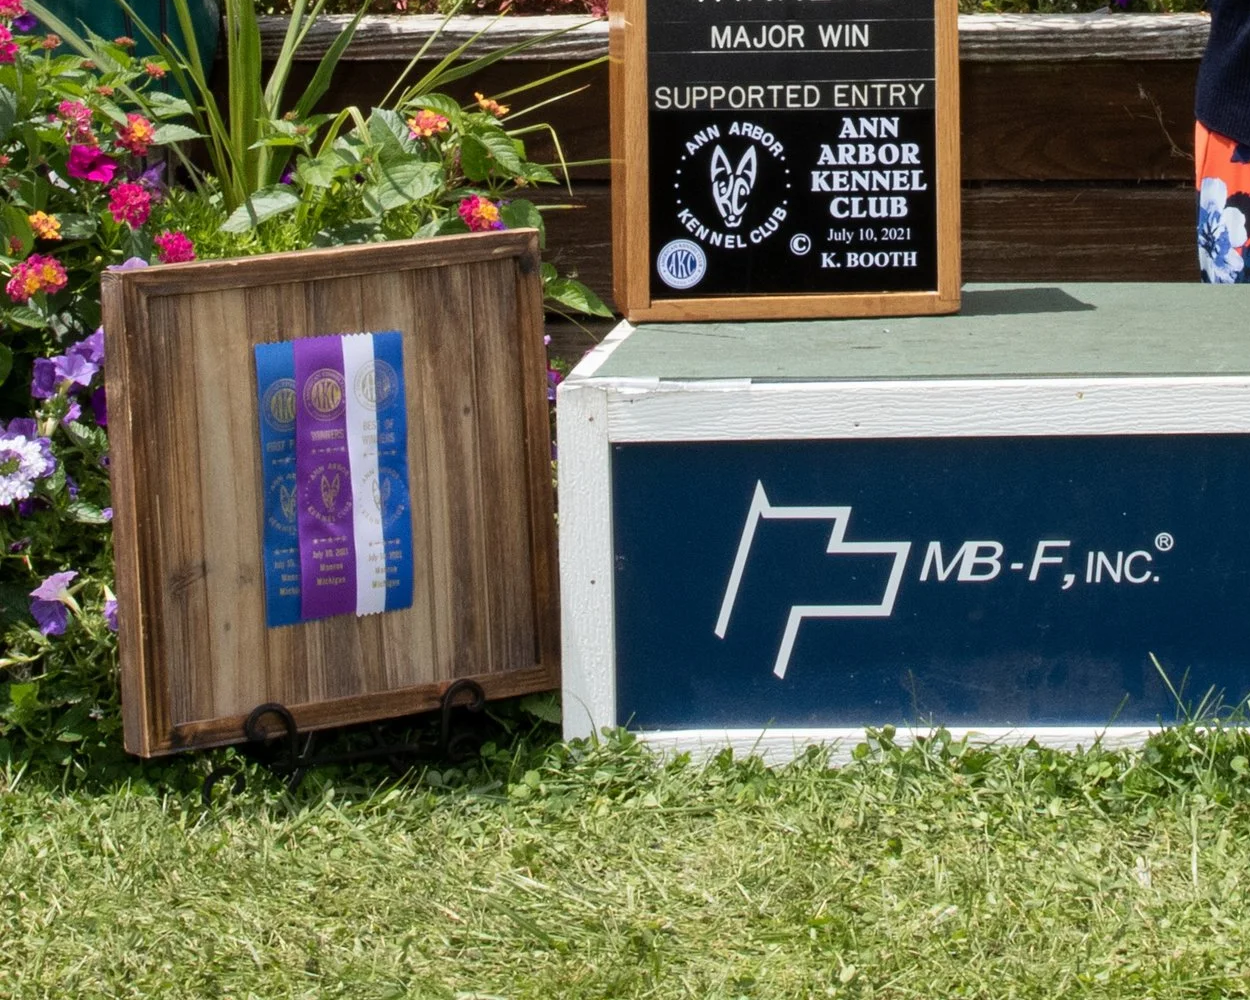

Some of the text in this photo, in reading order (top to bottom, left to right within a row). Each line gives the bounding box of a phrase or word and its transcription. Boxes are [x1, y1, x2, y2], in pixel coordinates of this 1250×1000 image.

[711, 24, 869, 48] MAJOR WIN
[655, 83, 925, 109] SUPPORTED ENTRY
[685, 121, 784, 157] ANN ARBOR
[839, 117, 899, 139] ANN
[816, 143, 921, 166] ARBOR
[811, 169, 928, 192] KENNEL
[829, 196, 909, 219] CLUB
[677, 206, 787, 248] KENNEL CLUB
[827, 227, 912, 243] July 10, 2021
[668, 249, 697, 278] AKC
[821, 251, 918, 268] K. BOOTH
